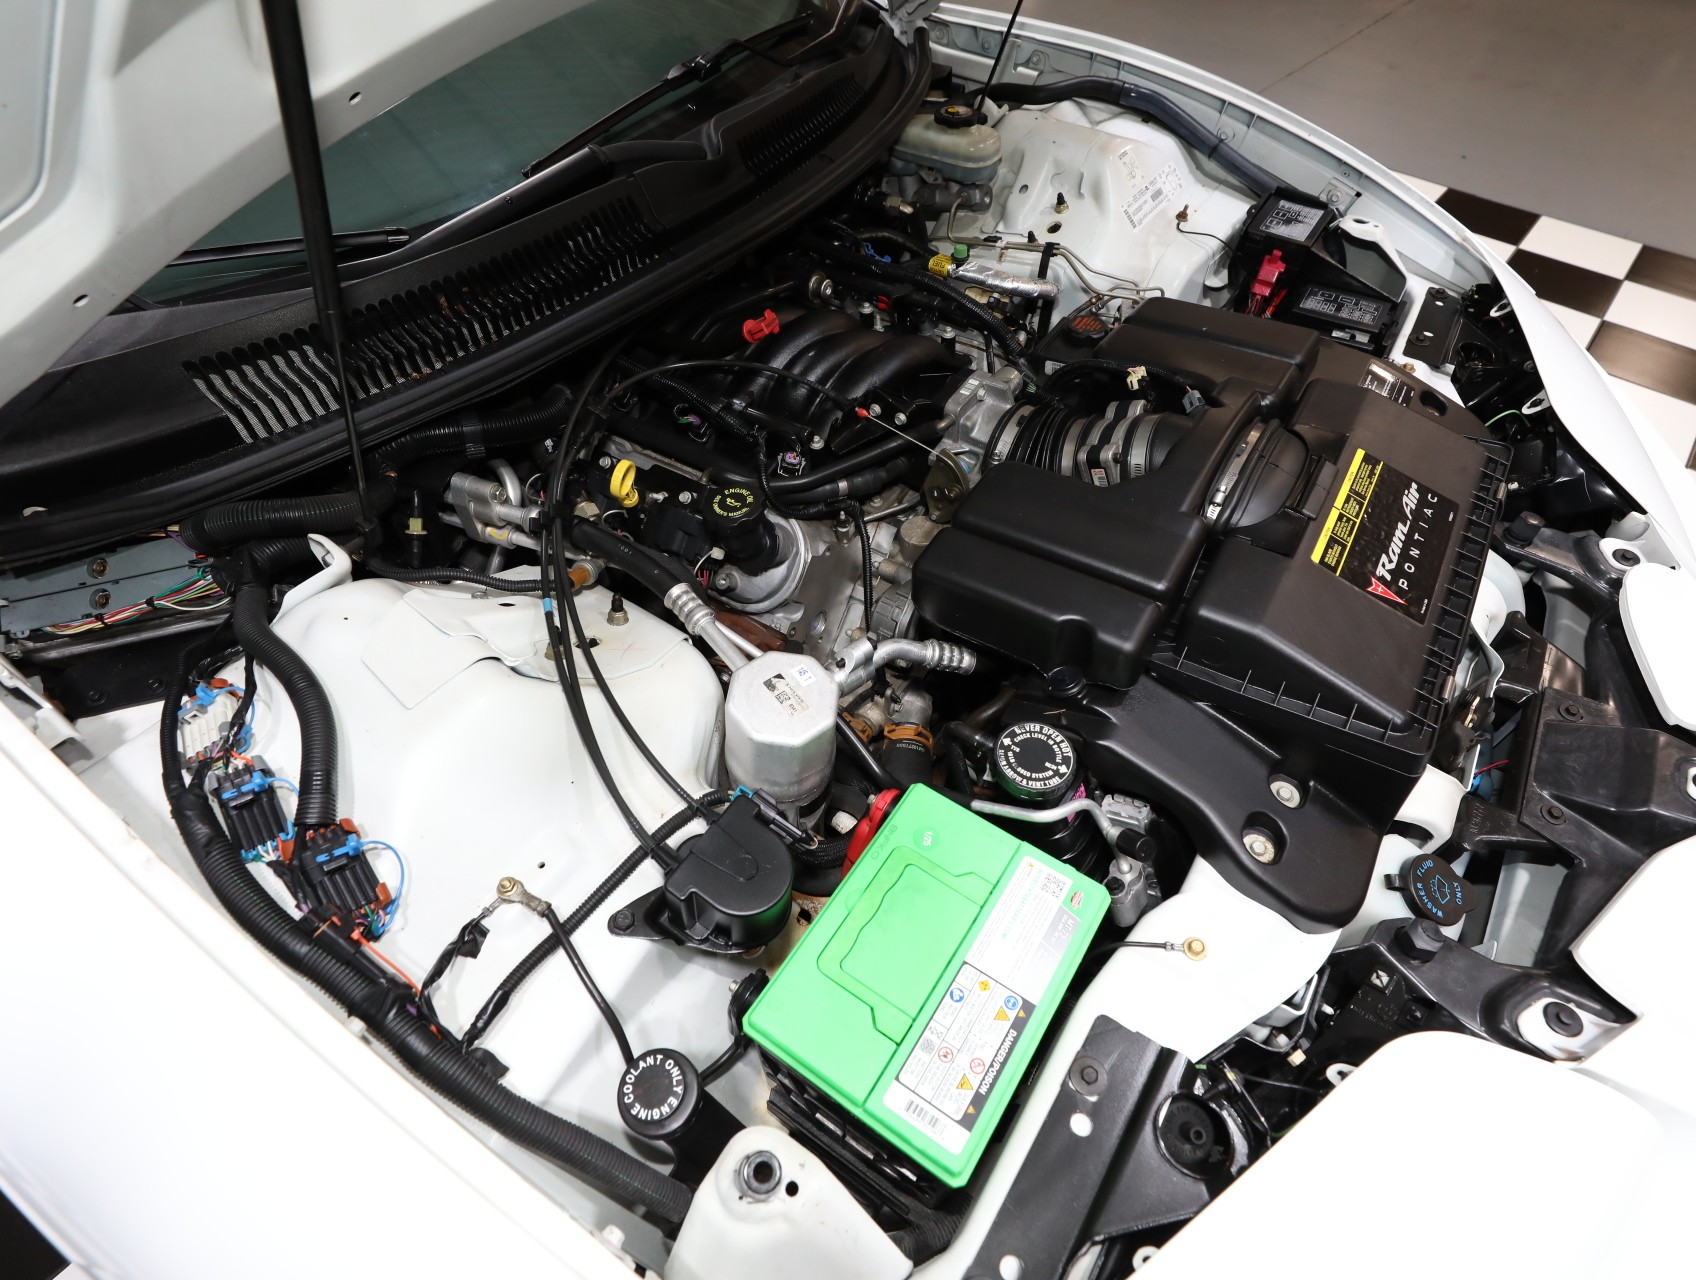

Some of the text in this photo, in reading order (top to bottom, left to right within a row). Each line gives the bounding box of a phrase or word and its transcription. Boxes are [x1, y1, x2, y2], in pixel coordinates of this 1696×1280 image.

[724, 488, 754, 504] ENGINE OIL
[1375, 481, 1421, 582] Ram Air
[1399, 493, 1438, 590] PONTIAC
[1014, 724, 1072, 757] NEVER OPEN HOT
[1014, 733, 1063, 763] CHECK LEVEL IN BOTTLE
[1003, 766, 1023, 783] ARROW
[1028, 780, 1045, 788] VENT
[1045, 776, 1061, 786] TUBE
[1032, 770, 1054, 779] SYSTEM
[1416, 859, 1434, 877] FLUID
[1416, 883, 1444, 919] WASHER
[1452, 881, 1463, 905] ONLY
[977, 1028, 1017, 1095] DANGER/POISON
[623, 1054, 684, 1103] COOLANT ONLY
[630, 1096, 678, 1120] ENGINE
